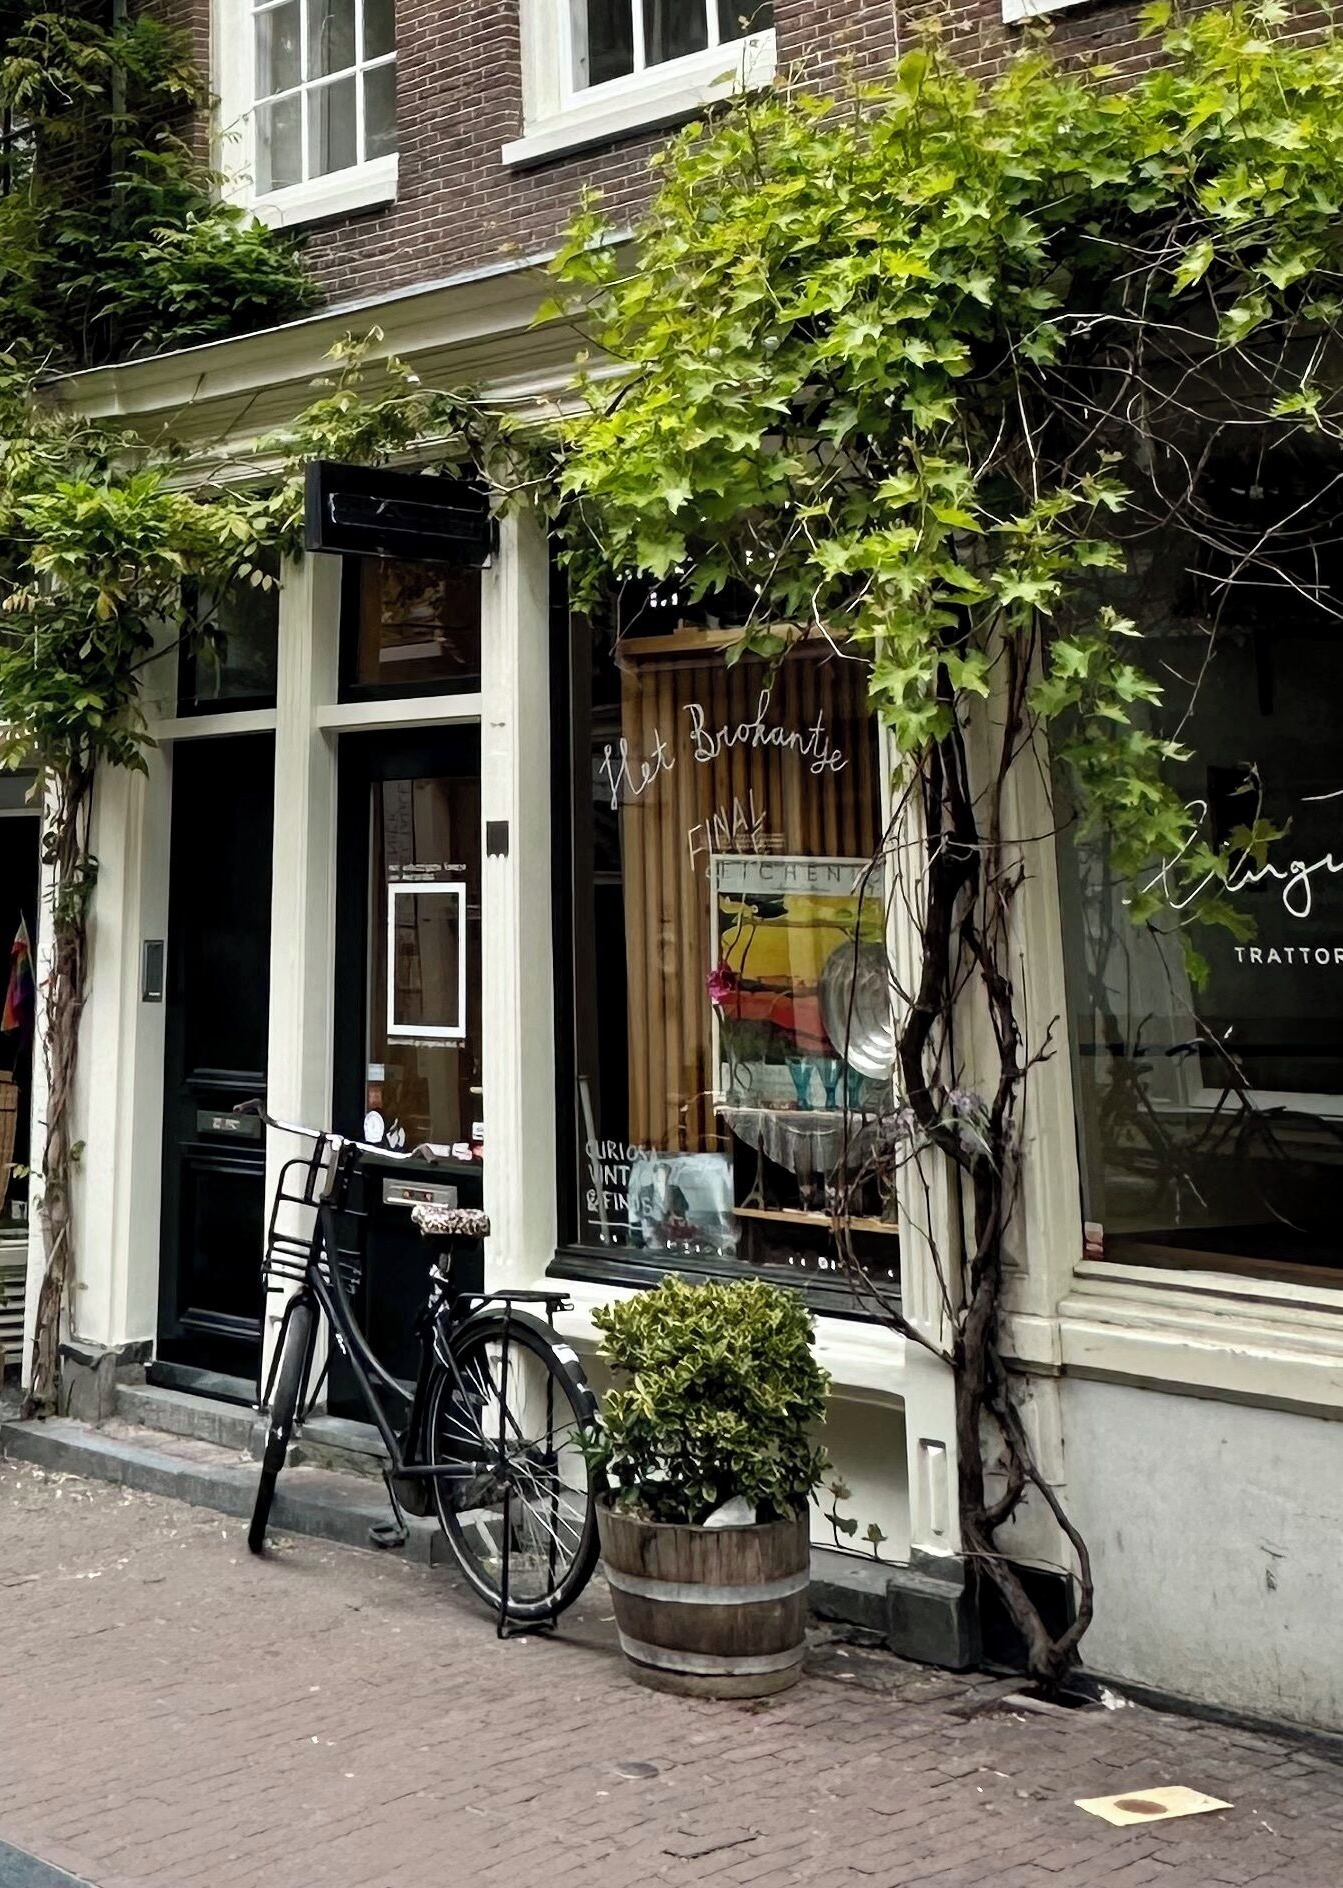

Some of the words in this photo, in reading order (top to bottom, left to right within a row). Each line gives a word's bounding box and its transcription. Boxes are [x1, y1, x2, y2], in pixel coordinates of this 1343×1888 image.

[599, 727, 675, 810] Het
[683, 689, 849, 774] Brokantje
[687, 788, 766, 872] FINAL
[1234, 946, 1343, 965] TRATTOR
